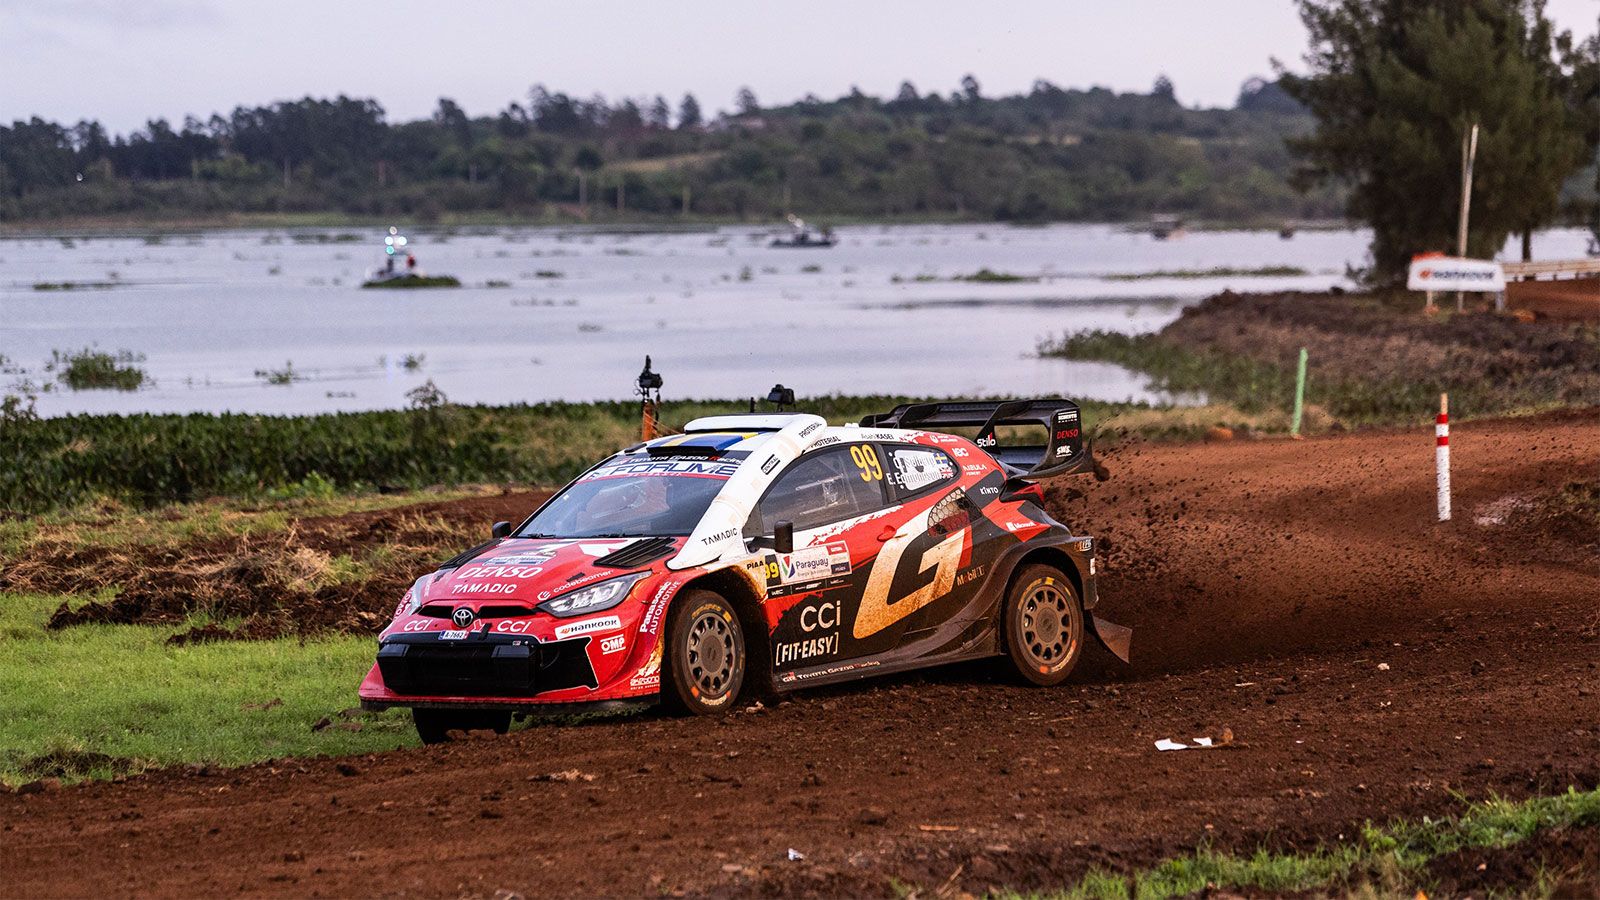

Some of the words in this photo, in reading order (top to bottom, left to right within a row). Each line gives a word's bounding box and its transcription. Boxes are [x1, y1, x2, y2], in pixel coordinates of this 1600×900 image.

[1056, 429, 1079, 440] DENSO
[849, 443, 883, 482] 99
[700, 527, 738, 546] TAMADIC
[746, 560, 764, 570] PIAA
[795, 557, 829, 570] Paraguay
[457, 566, 544, 579] DENSO
[451, 583, 518, 595] TAMADIC
[640, 580, 672, 634] Panasonic
[649, 580, 682, 635] AUTOMOTIVE
[800, 600, 841, 633] CCi
[601, 636, 625, 651] OMP
